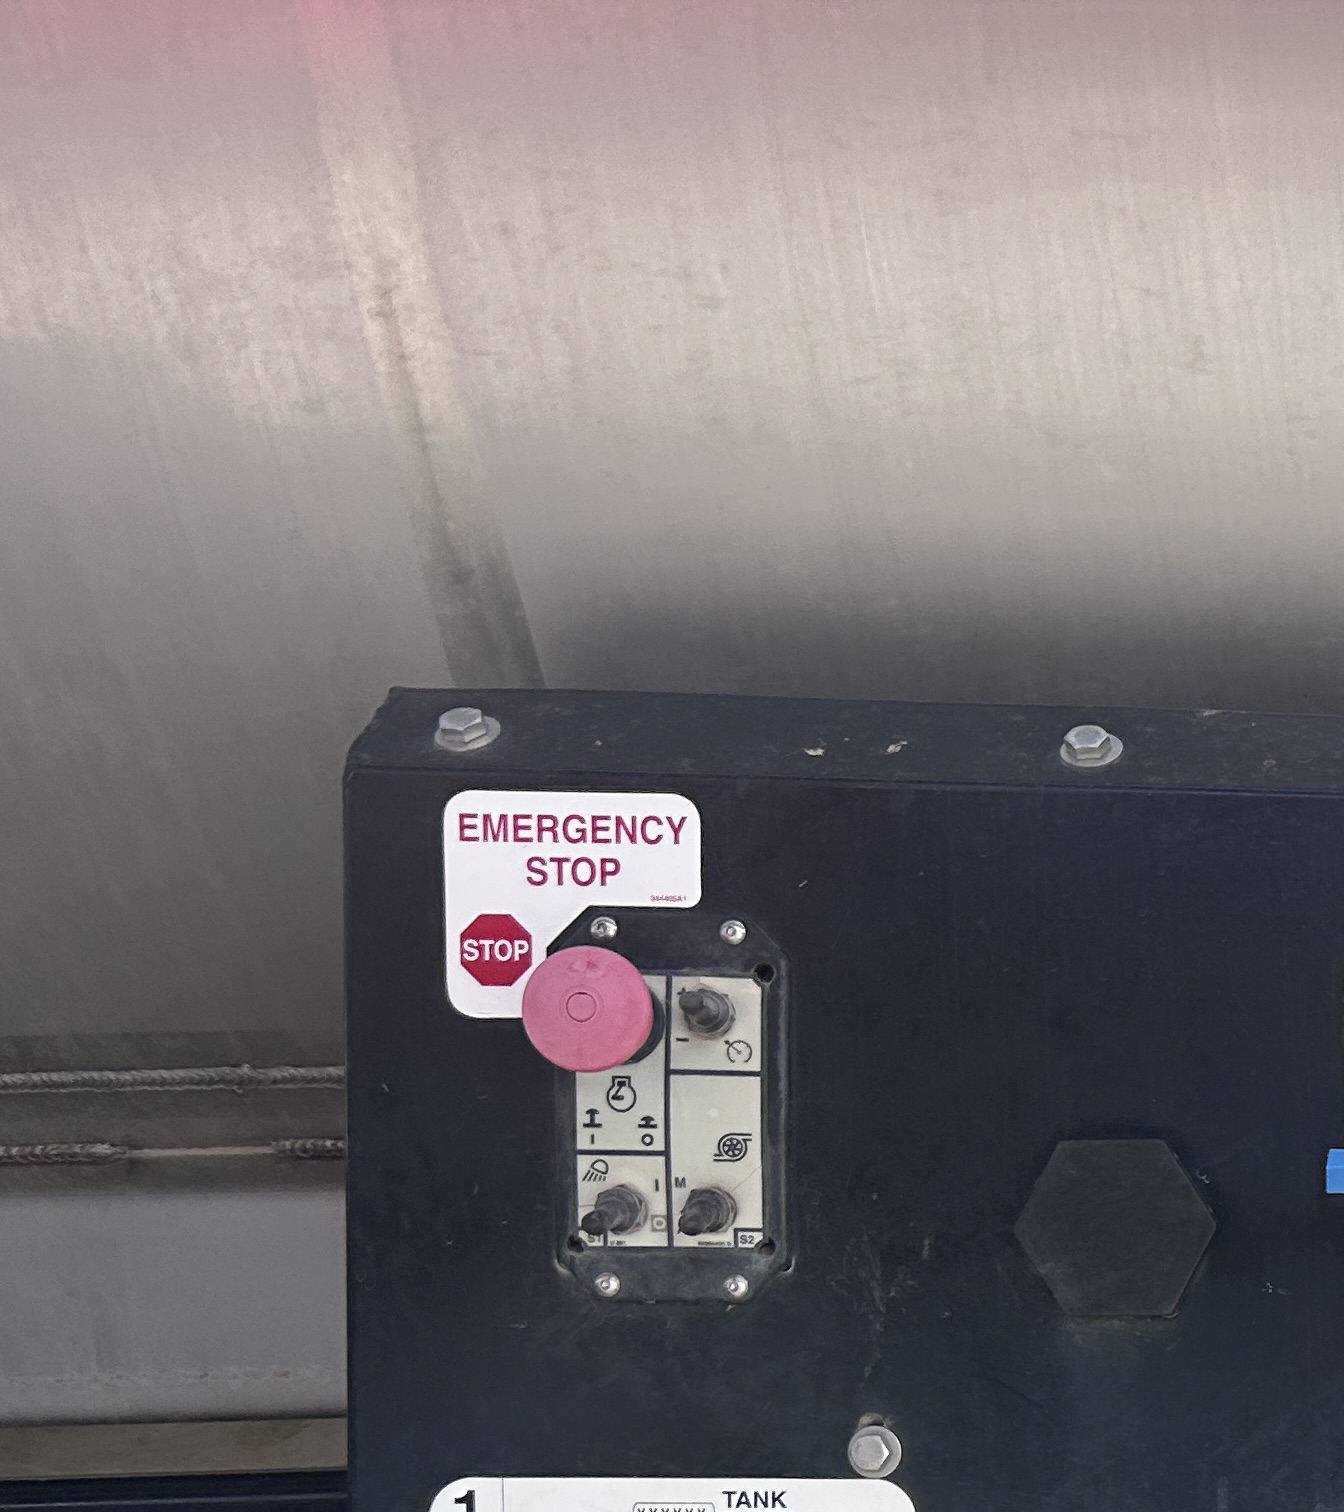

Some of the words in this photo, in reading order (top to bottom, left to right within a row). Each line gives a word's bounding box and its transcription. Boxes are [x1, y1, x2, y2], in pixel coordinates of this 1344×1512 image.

[458, 812, 688, 845] EMERGENCY
[526, 856, 621, 887] STOP
[461, 938, 531, 962] STOP
[740, 1234, 755, 1245] S2
[722, 1490, 787, 1510] TANK
